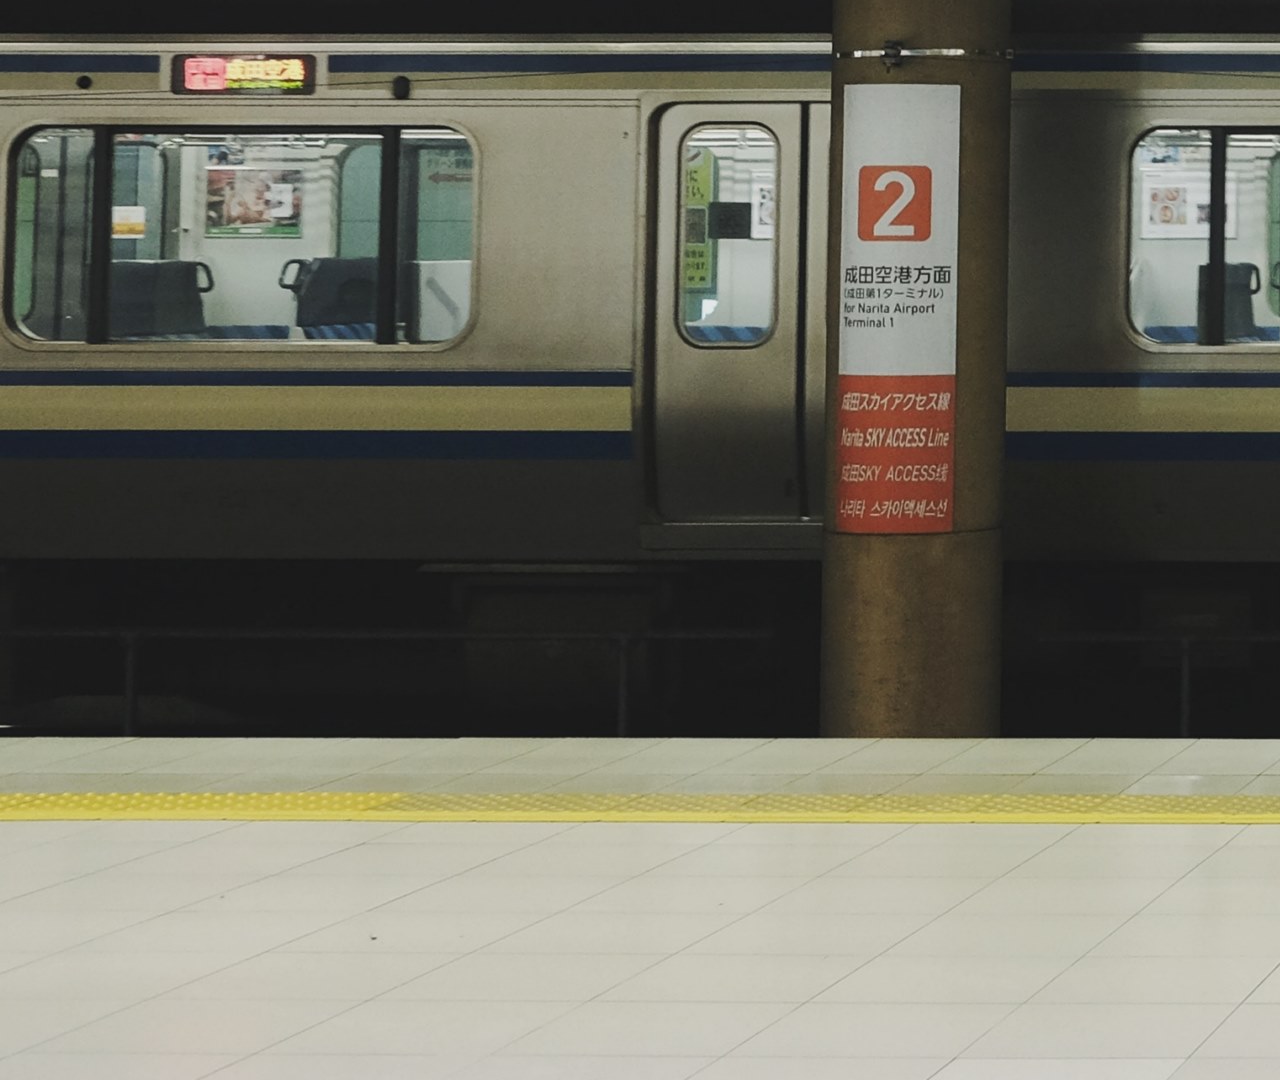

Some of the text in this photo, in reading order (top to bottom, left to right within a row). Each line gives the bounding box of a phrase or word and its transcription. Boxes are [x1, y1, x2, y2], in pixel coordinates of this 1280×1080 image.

[873, 171, 916, 237] 2
[844, 265, 952, 284] 成田空港方面
[844, 302, 936, 316] for Narita Airport
[844, 316, 886, 328] Terminal
[841, 391, 951, 412] 成田スカイアクセス線
[841, 427, 950, 448] Narita SKY ACCESS Line
[840, 498, 866, 519] 나리타
